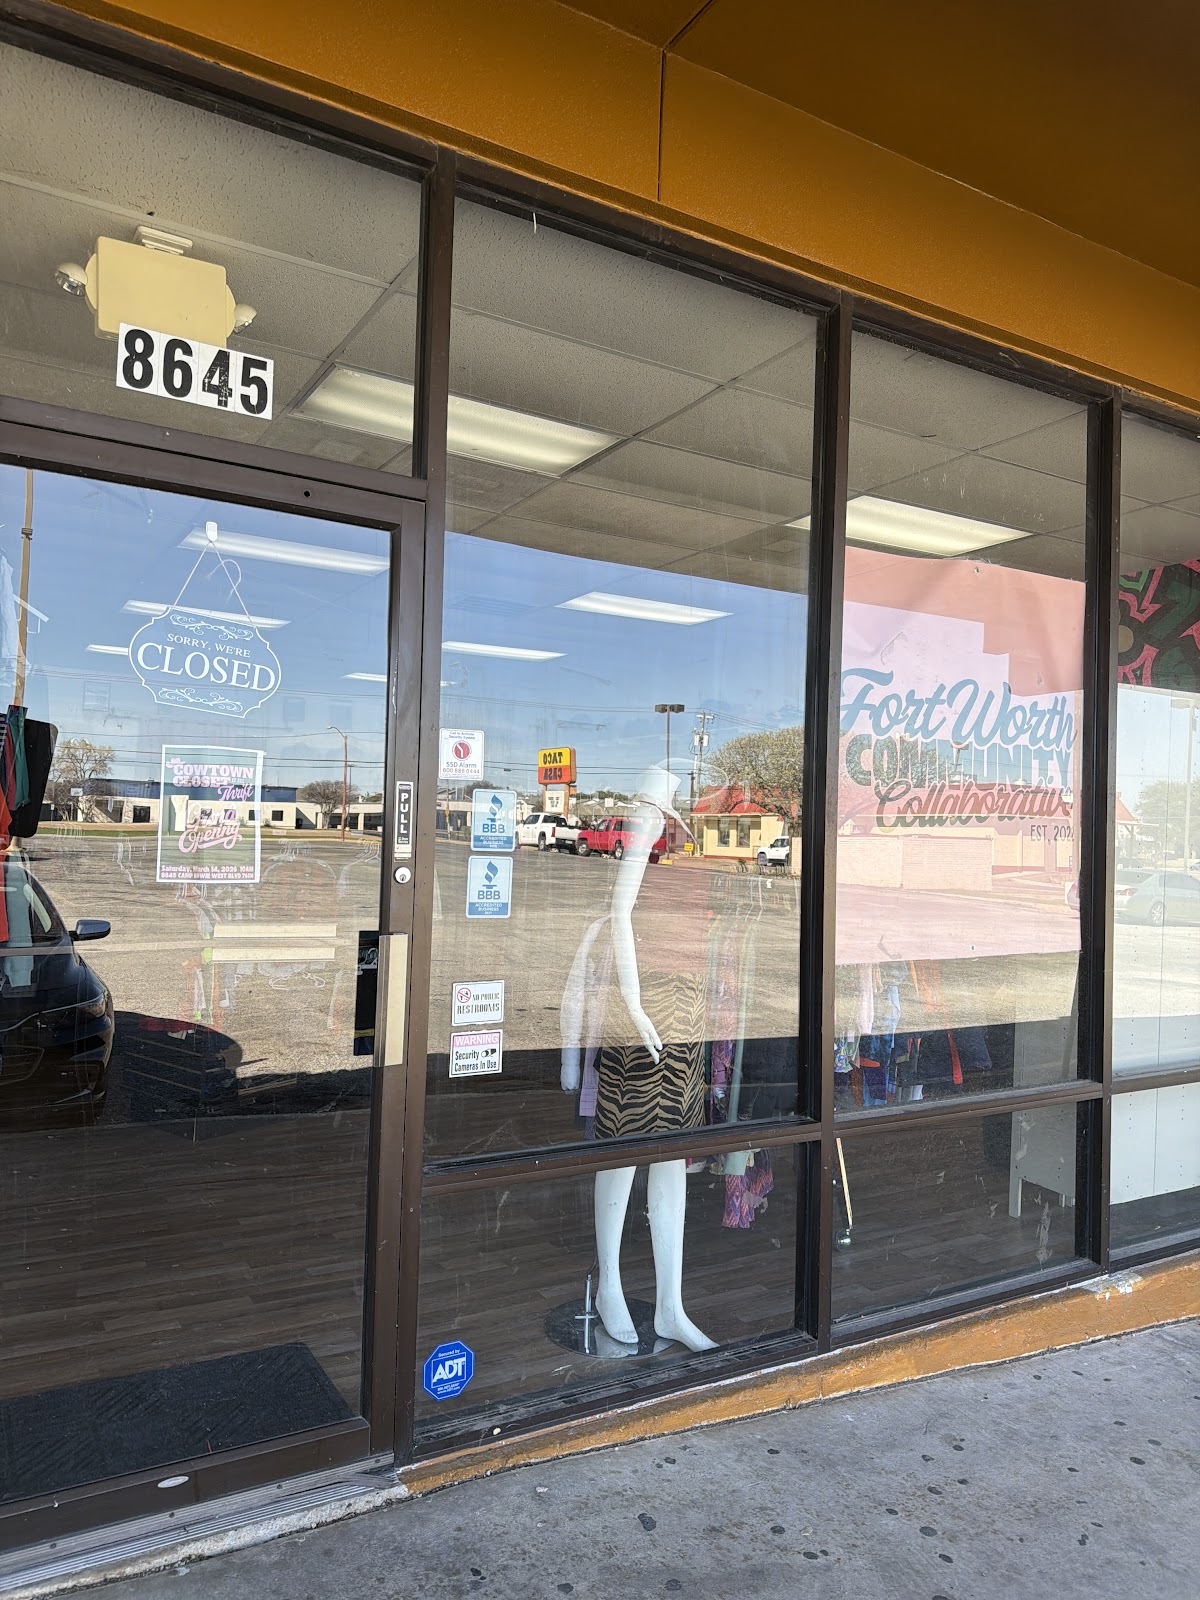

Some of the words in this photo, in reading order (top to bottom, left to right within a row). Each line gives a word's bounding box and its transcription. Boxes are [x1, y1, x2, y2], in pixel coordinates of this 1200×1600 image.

[122, 329, 268, 415] 8645
[167, 633, 211, 651] SORRY,
[214, 643, 251, 658] WE'RE
[137, 642, 276, 692] CLOSED
[840, 667, 947, 739] Fort
[946, 678, 1074, 751] Worth
[845, 733, 1072, 791] COMMUNITY
[173, 764, 255, 779] COWTOWN
[172, 775, 231, 788] CLOSET
[217, 783, 254, 802] Thrift
[400, 792, 409, 834] PULL
[482, 823, 506, 834] BBB
[178, 822, 243, 853] Opening
[161, 865, 192, 873] Saturday,
[477, 890, 501, 900] BBB
[480, 992, 500, 1001] PUBLIC
[457, 1002, 500, 1015] RESTROOMS
[454, 1034, 499, 1047] WARNING
[454, 1049, 480, 1061] Security
[454, 1062, 479, 1072] Cameras
[480, 1061, 486, 1070] In
[486, 1060, 497, 1069] Use
[432, 1356, 466, 1383] ADT
